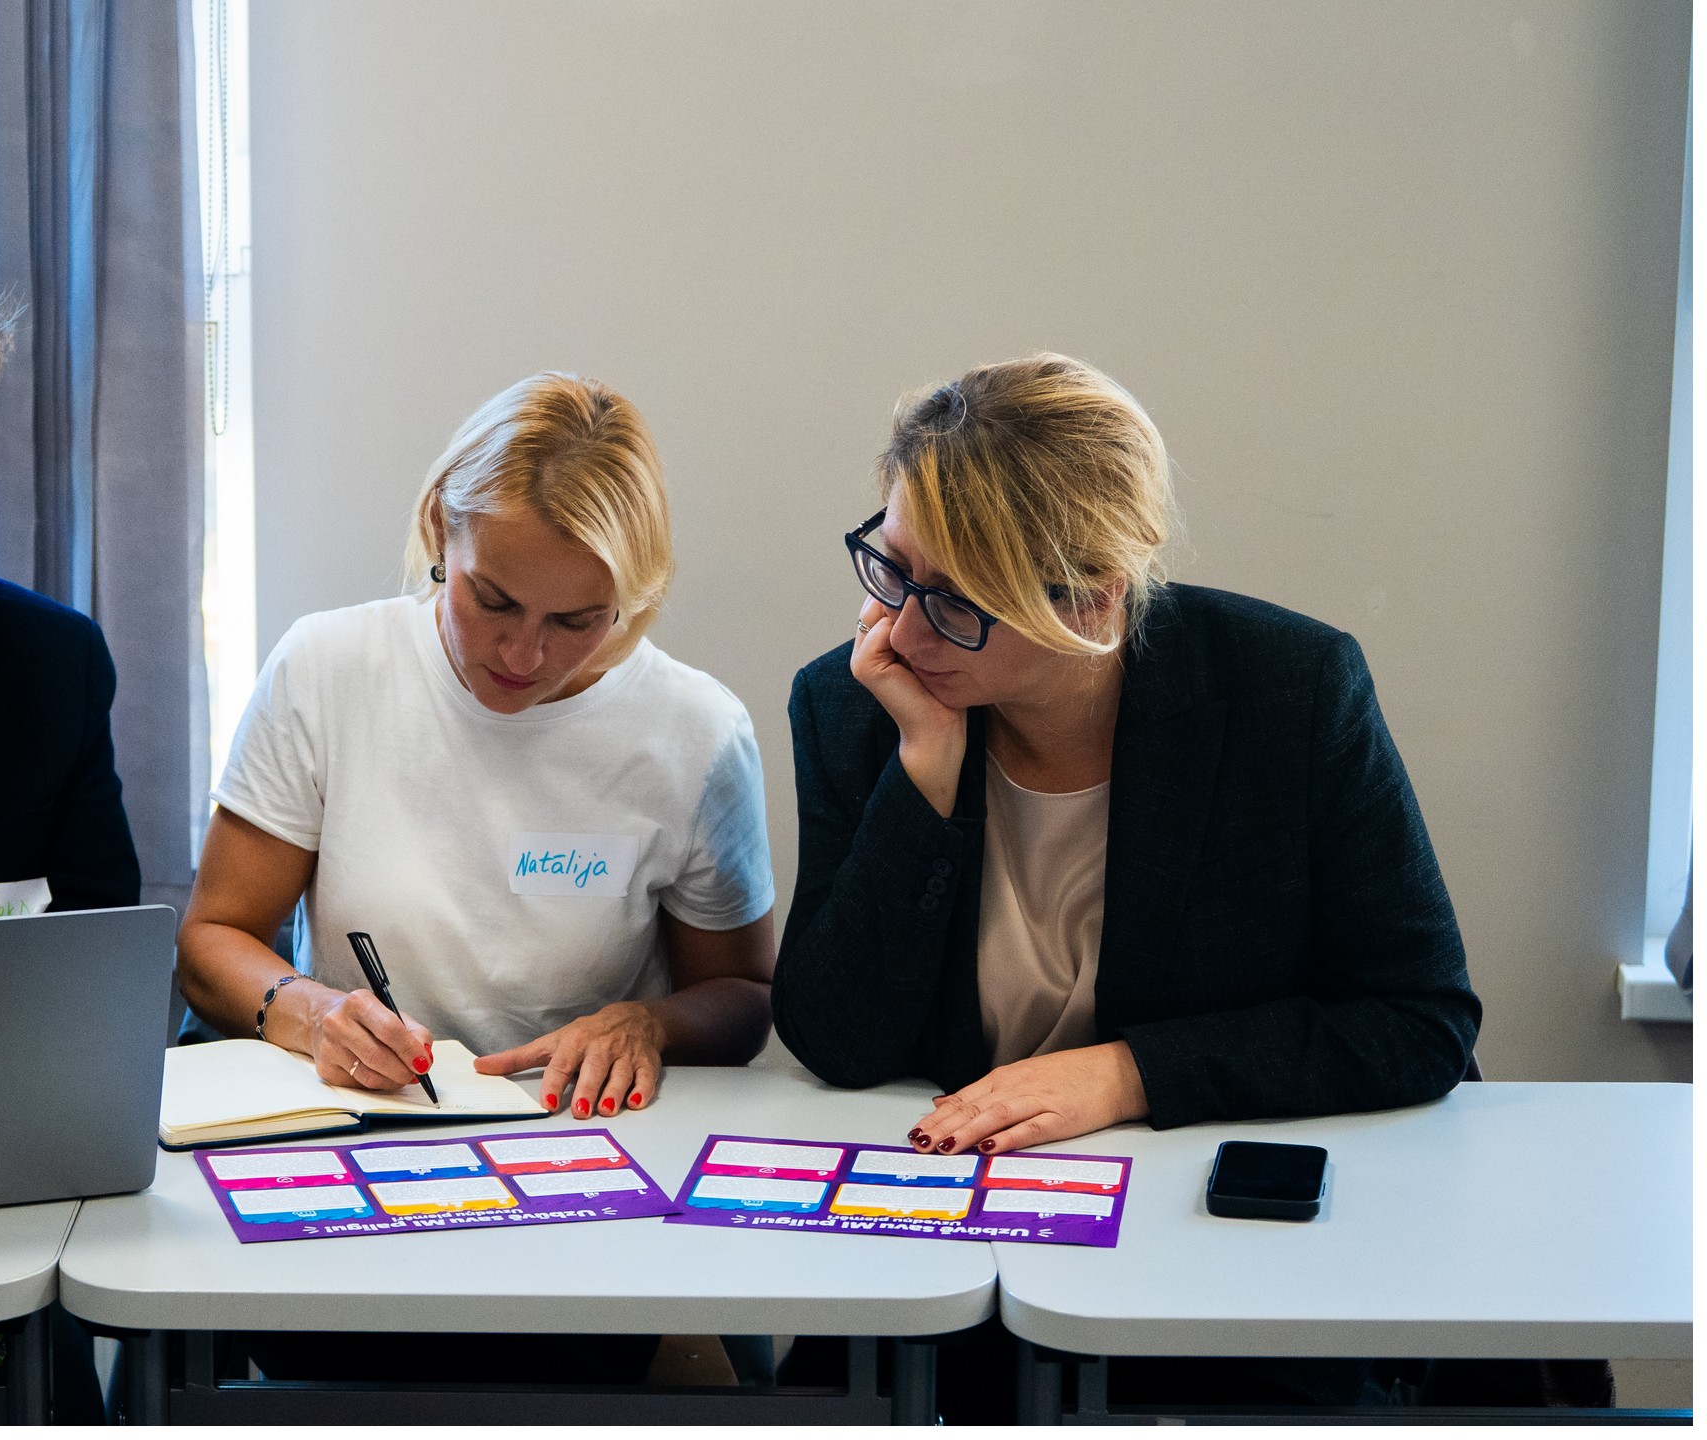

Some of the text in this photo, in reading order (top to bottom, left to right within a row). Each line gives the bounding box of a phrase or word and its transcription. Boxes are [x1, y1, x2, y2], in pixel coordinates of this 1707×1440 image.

[516, 849, 608, 888] Natālija
[324, 1209, 596, 1233] Uzbūvē savu MI palīgu!
[392, 1208, 524, 1222] Uzvedņu piemēri
[895, 1217, 961, 1226] Uzvedņu
[751, 1216, 1030, 1237] Uzbūvē savu MI palīgu!
